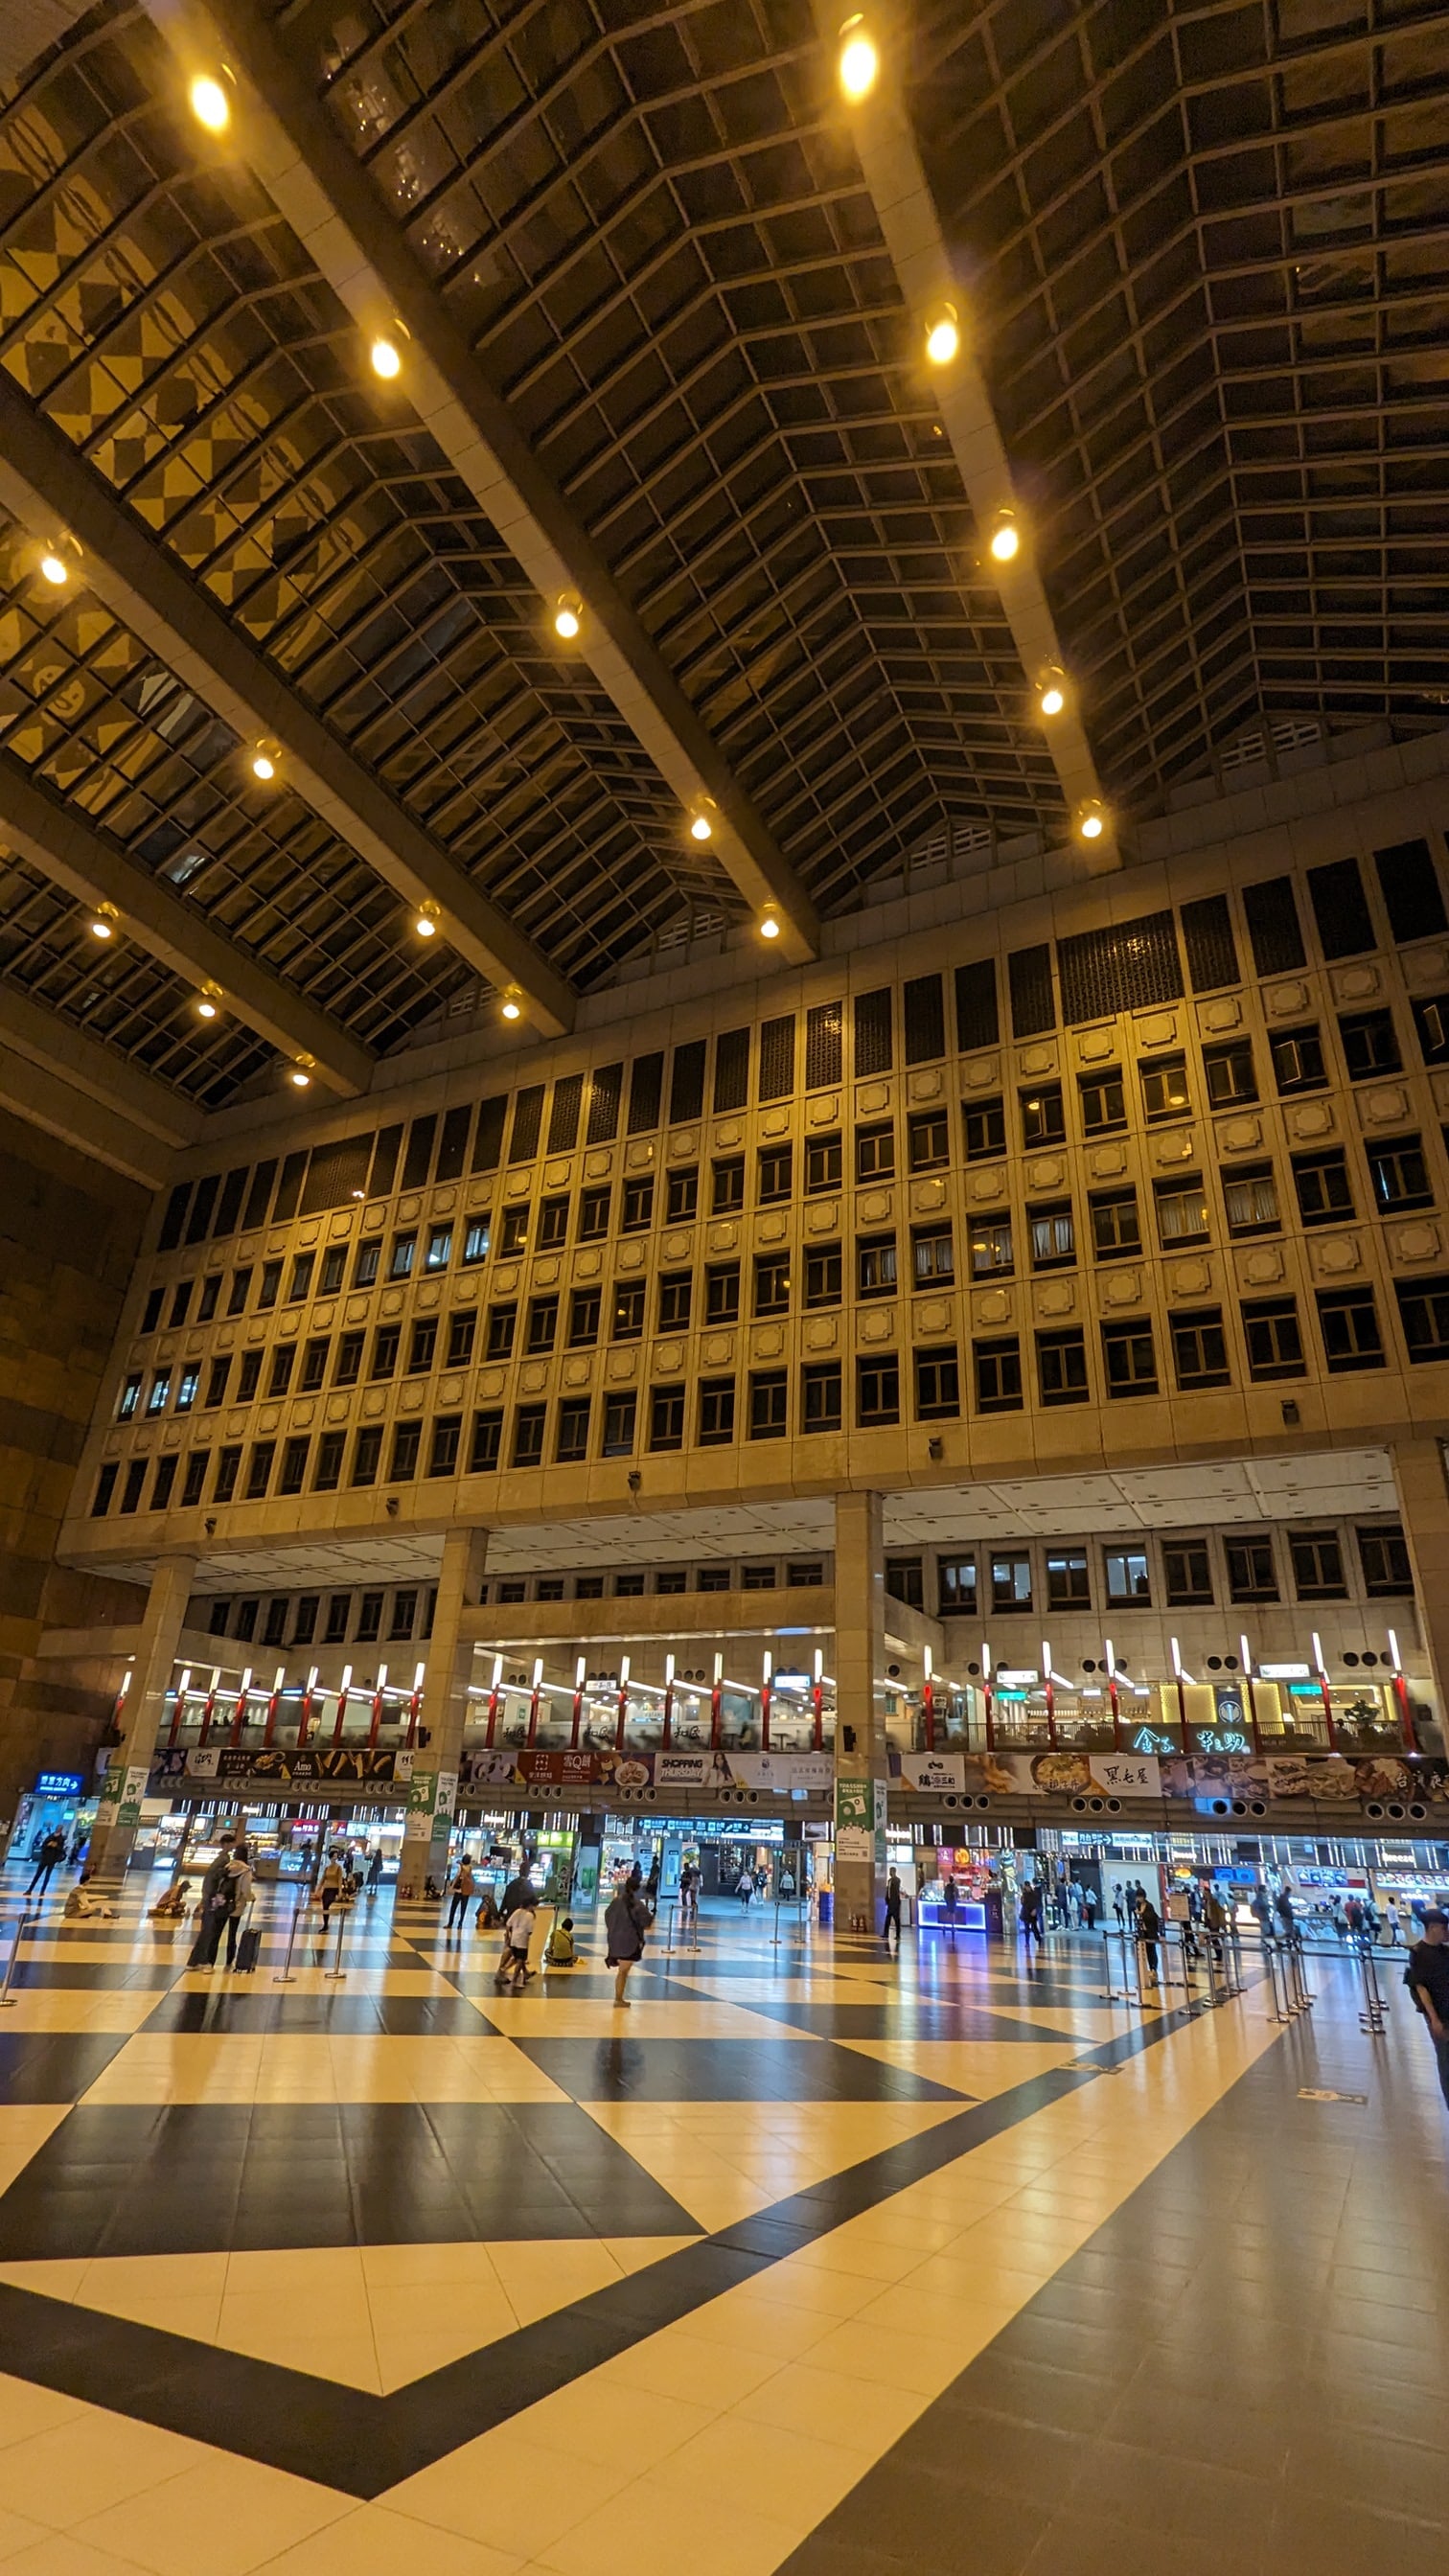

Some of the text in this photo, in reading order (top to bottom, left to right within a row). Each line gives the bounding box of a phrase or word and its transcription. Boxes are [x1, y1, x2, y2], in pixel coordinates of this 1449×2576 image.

[293, 1760, 311, 1771] Amo
[661, 1759, 702, 1768] SHOPPING
[660, 1768, 702, 1778] THURSDAY
[1103, 1765, 1149, 1785] 黑毛屋
[1382, 1852, 1414, 1863] Breeze
